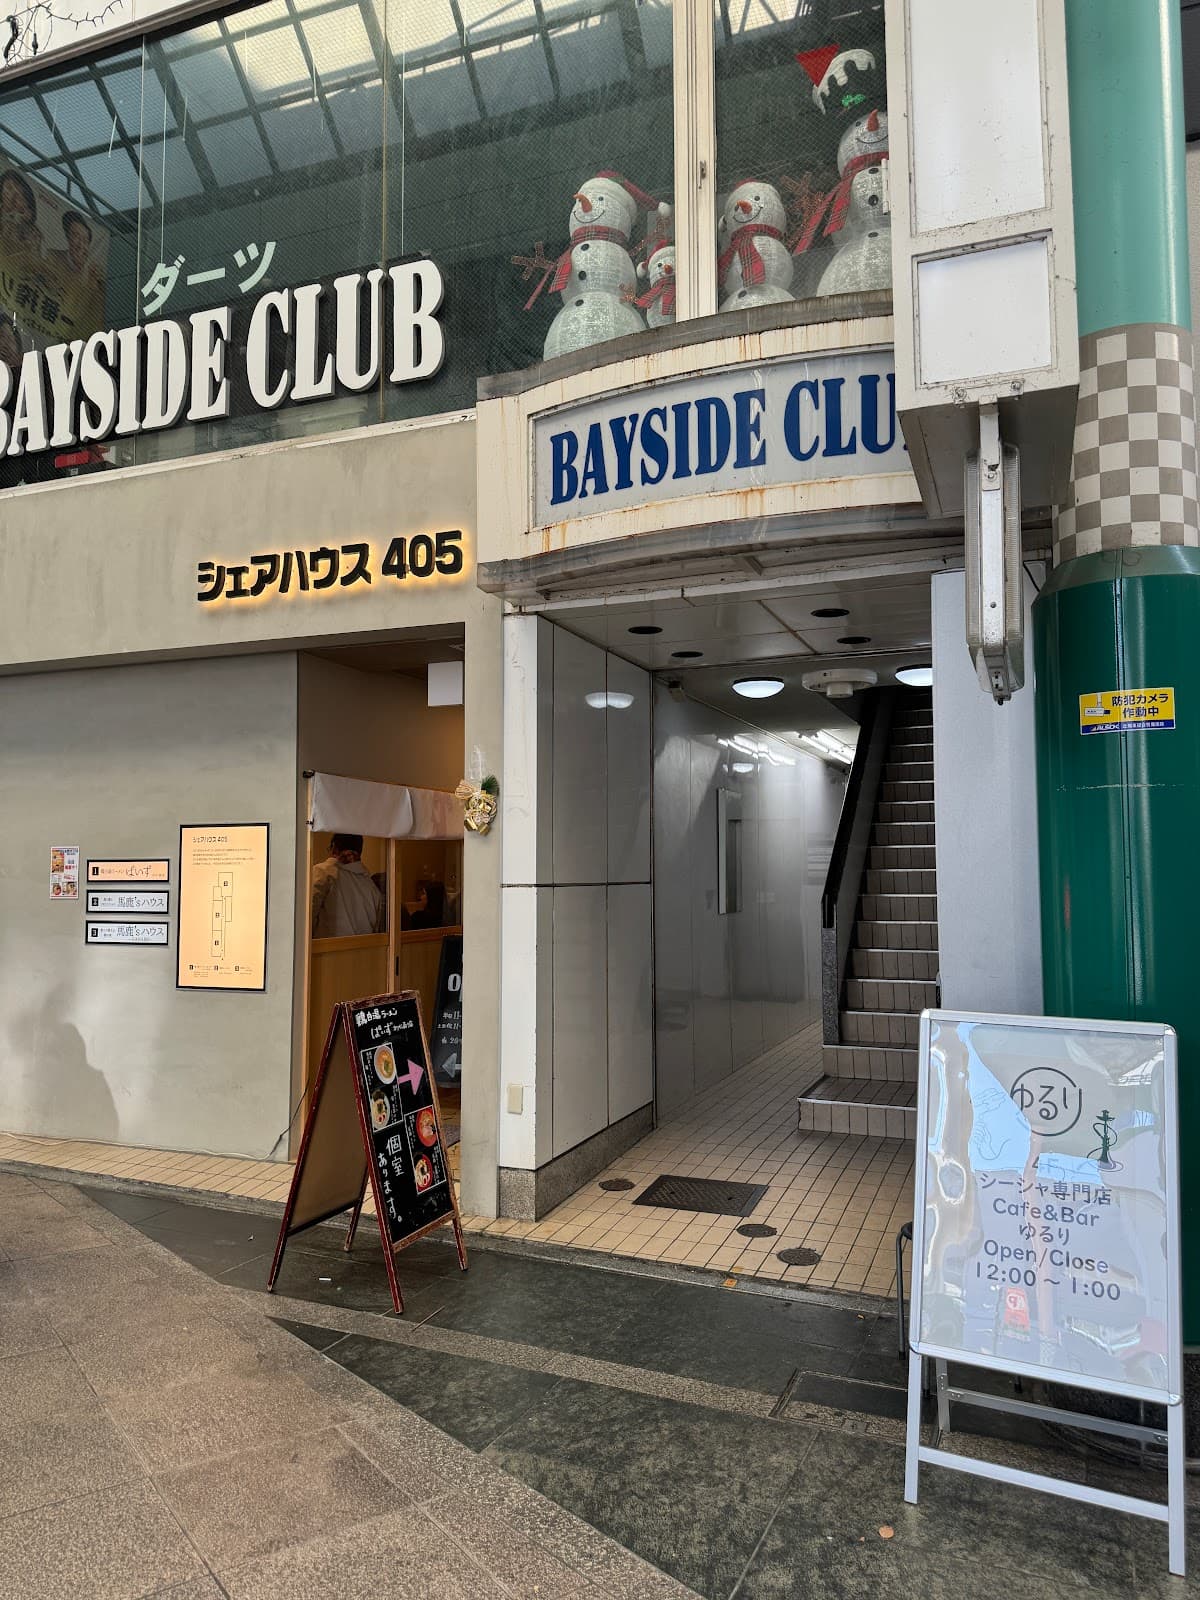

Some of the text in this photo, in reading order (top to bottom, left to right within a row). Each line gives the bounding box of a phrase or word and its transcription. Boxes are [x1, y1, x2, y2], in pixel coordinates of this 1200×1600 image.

[141, 241, 277, 316] ダーツ
[246, 258, 446, 409] CLUB
[550, 373, 909, 505] BAYSIDE CLU
[197, 529, 463, 601] シェアハウス 405
[1112, 693, 1169, 707] 防犯カメラ
[1123, 706, 1159, 719] 作動中
[386, 1134, 405, 1177] 個室
[378, 1152, 403, 1222] あります。
[979, 1173, 1113, 1206] シーシャ専門店
[992, 1198, 1100, 1227] Cafe&Bar
[1019, 1223, 1070, 1246] ゆるり
[984, 1239, 1109, 1274] Open/Close
